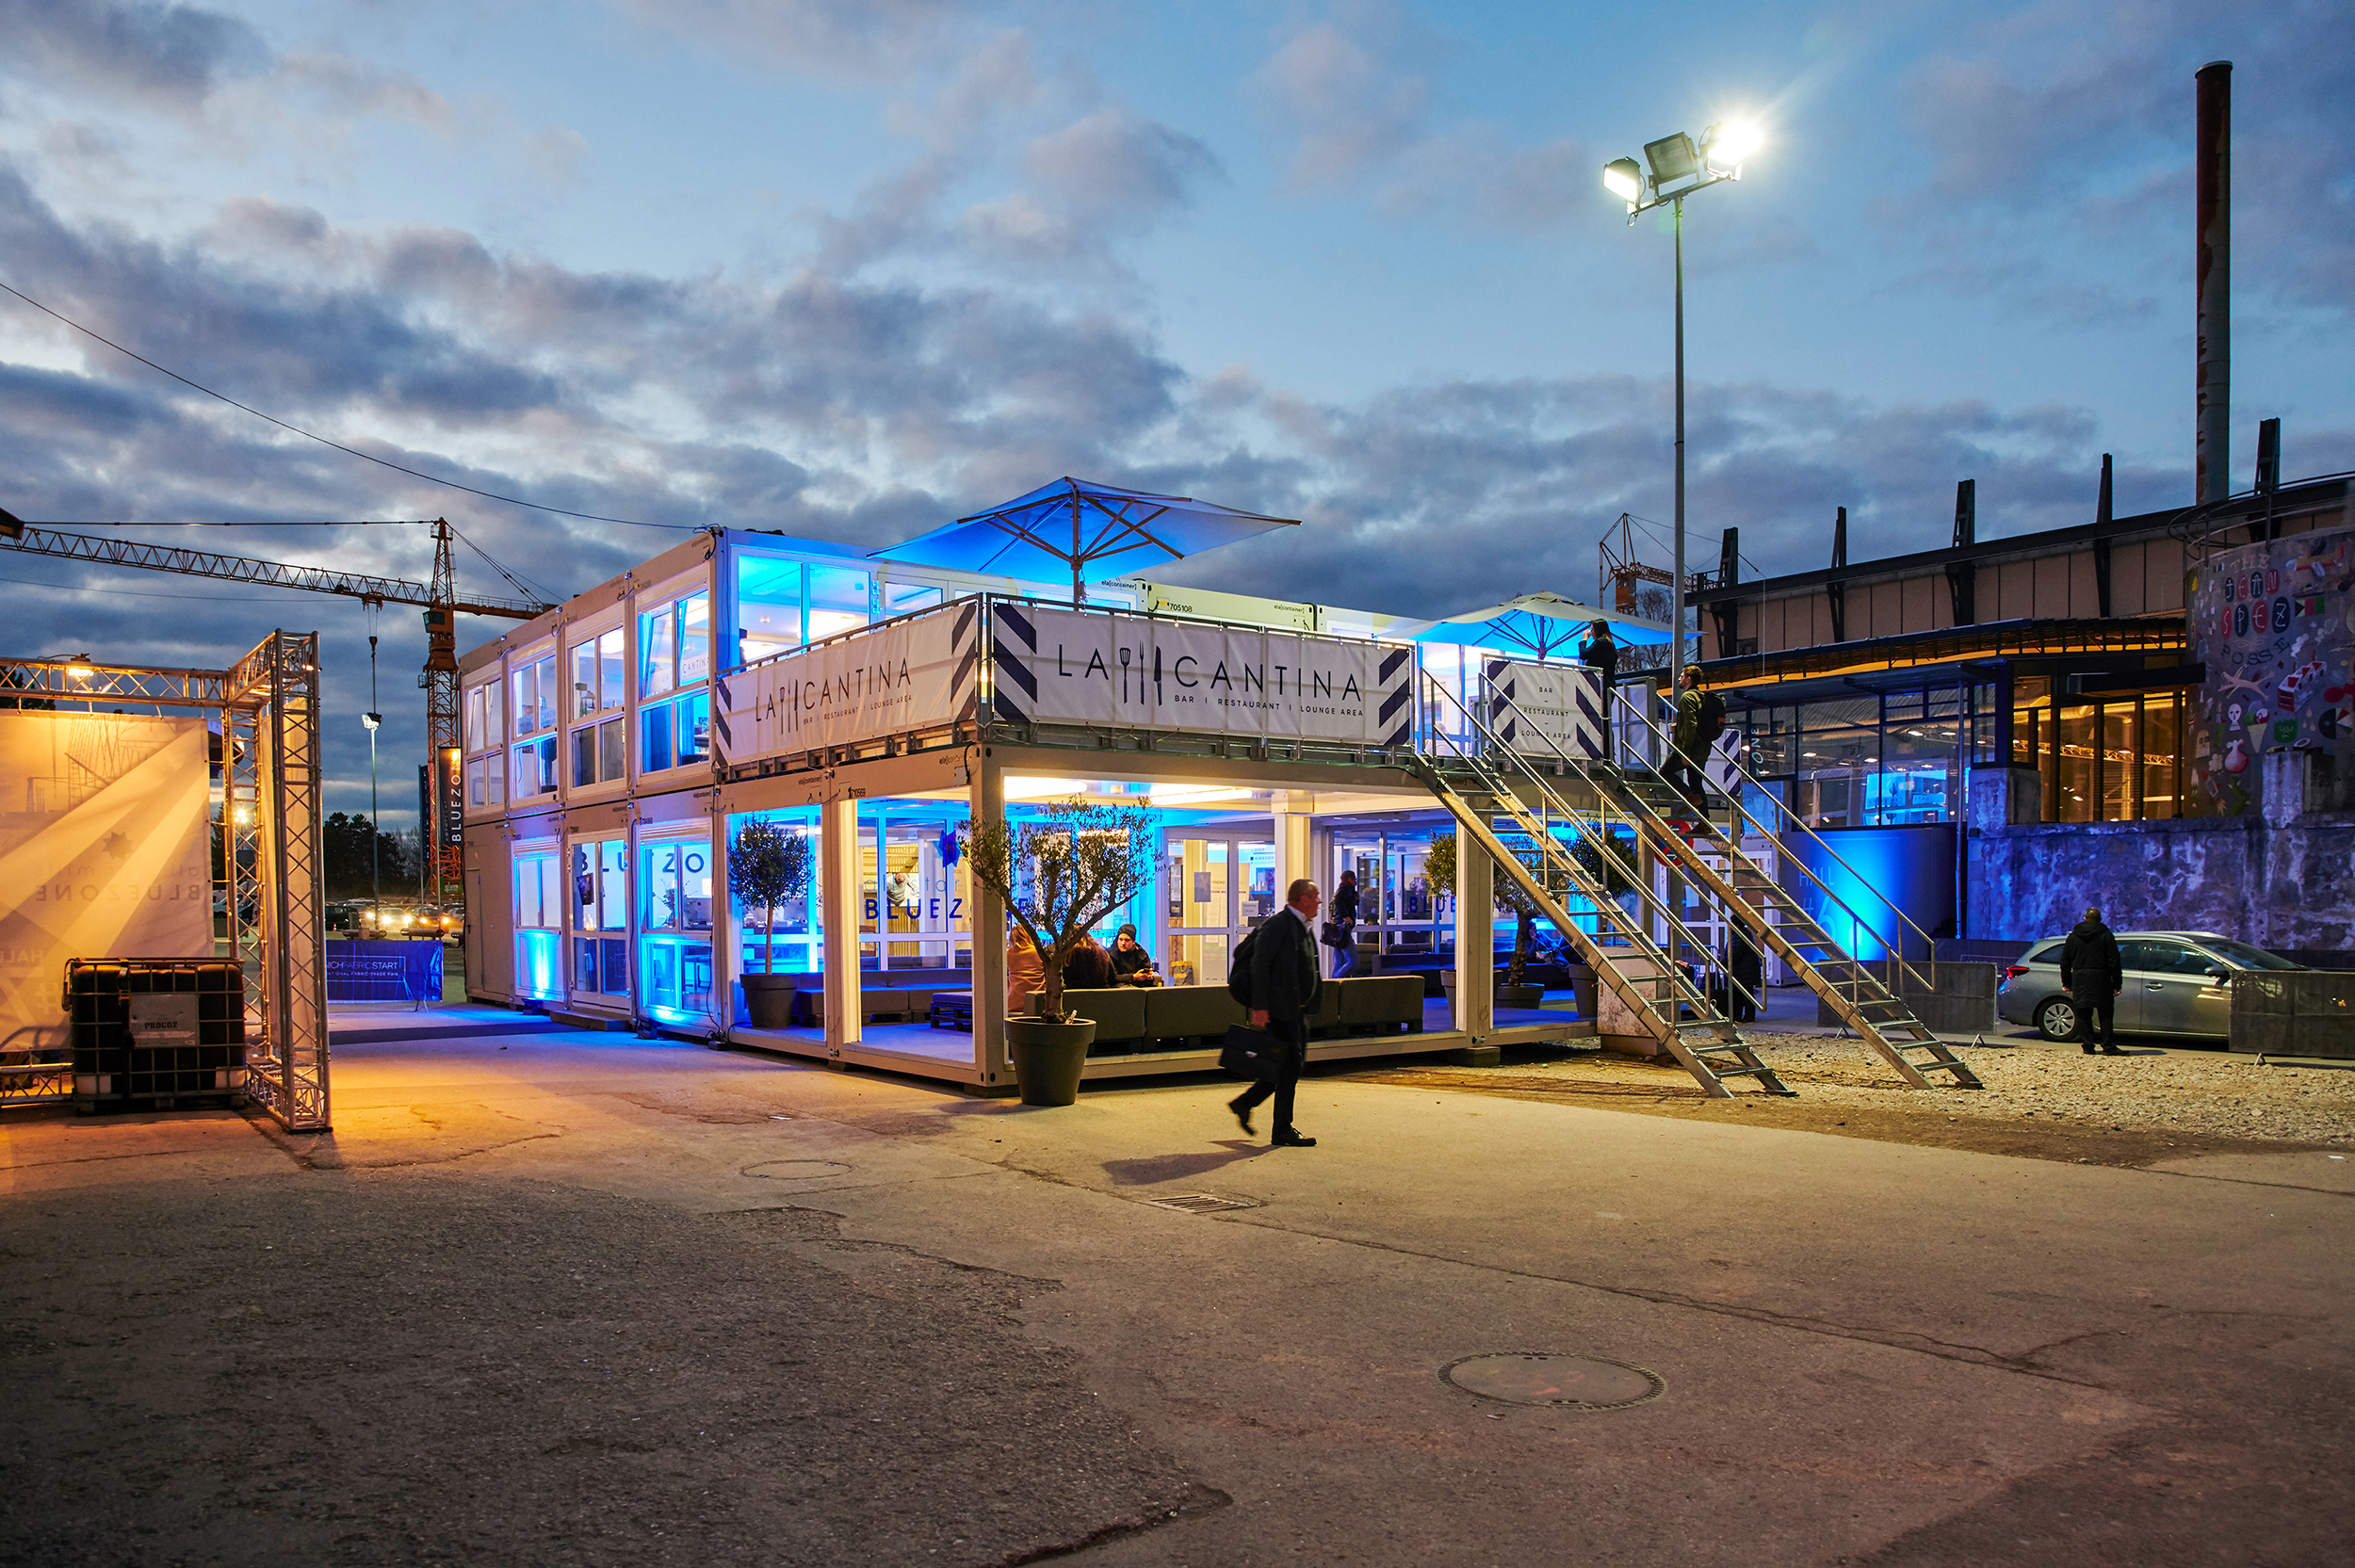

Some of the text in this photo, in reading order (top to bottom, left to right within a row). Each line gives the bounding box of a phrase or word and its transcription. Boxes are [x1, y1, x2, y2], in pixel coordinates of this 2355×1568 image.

[2230, 554, 2271, 574] THE
[2225, 570, 2278, 599] JEAN
[1170, 603, 1194, 613] 705108
[2223, 603, 2286, 635] SPEZ
[2219, 637, 2291, 666] POSSE
[1059, 644, 1362, 703] LA CANTINA
[755, 657, 912, 721] LA CANTINA
[1539, 686, 1553, 694] BAR
[803, 716, 814, 726] BAR
[823, 706, 859, 721] RESTAURANT
[870, 698, 894, 711] LOUNGE
[896, 694, 913, 704] AREA
[1174, 694, 1194, 703] BAR
[1217, 698, 1280, 711] RESTAURANT
[1300, 705, 1336, 715] LOUNGE
[1340, 708, 1364, 717] AREA
[1523, 706, 1569, 718] RESTAURANT
[1520, 730, 1550, 738] LOUNE
[450, 757, 462, 842] BLUEZON
[865, 897, 964, 920] BLUEZ
[1409, 896, 1456, 913] BLUE
